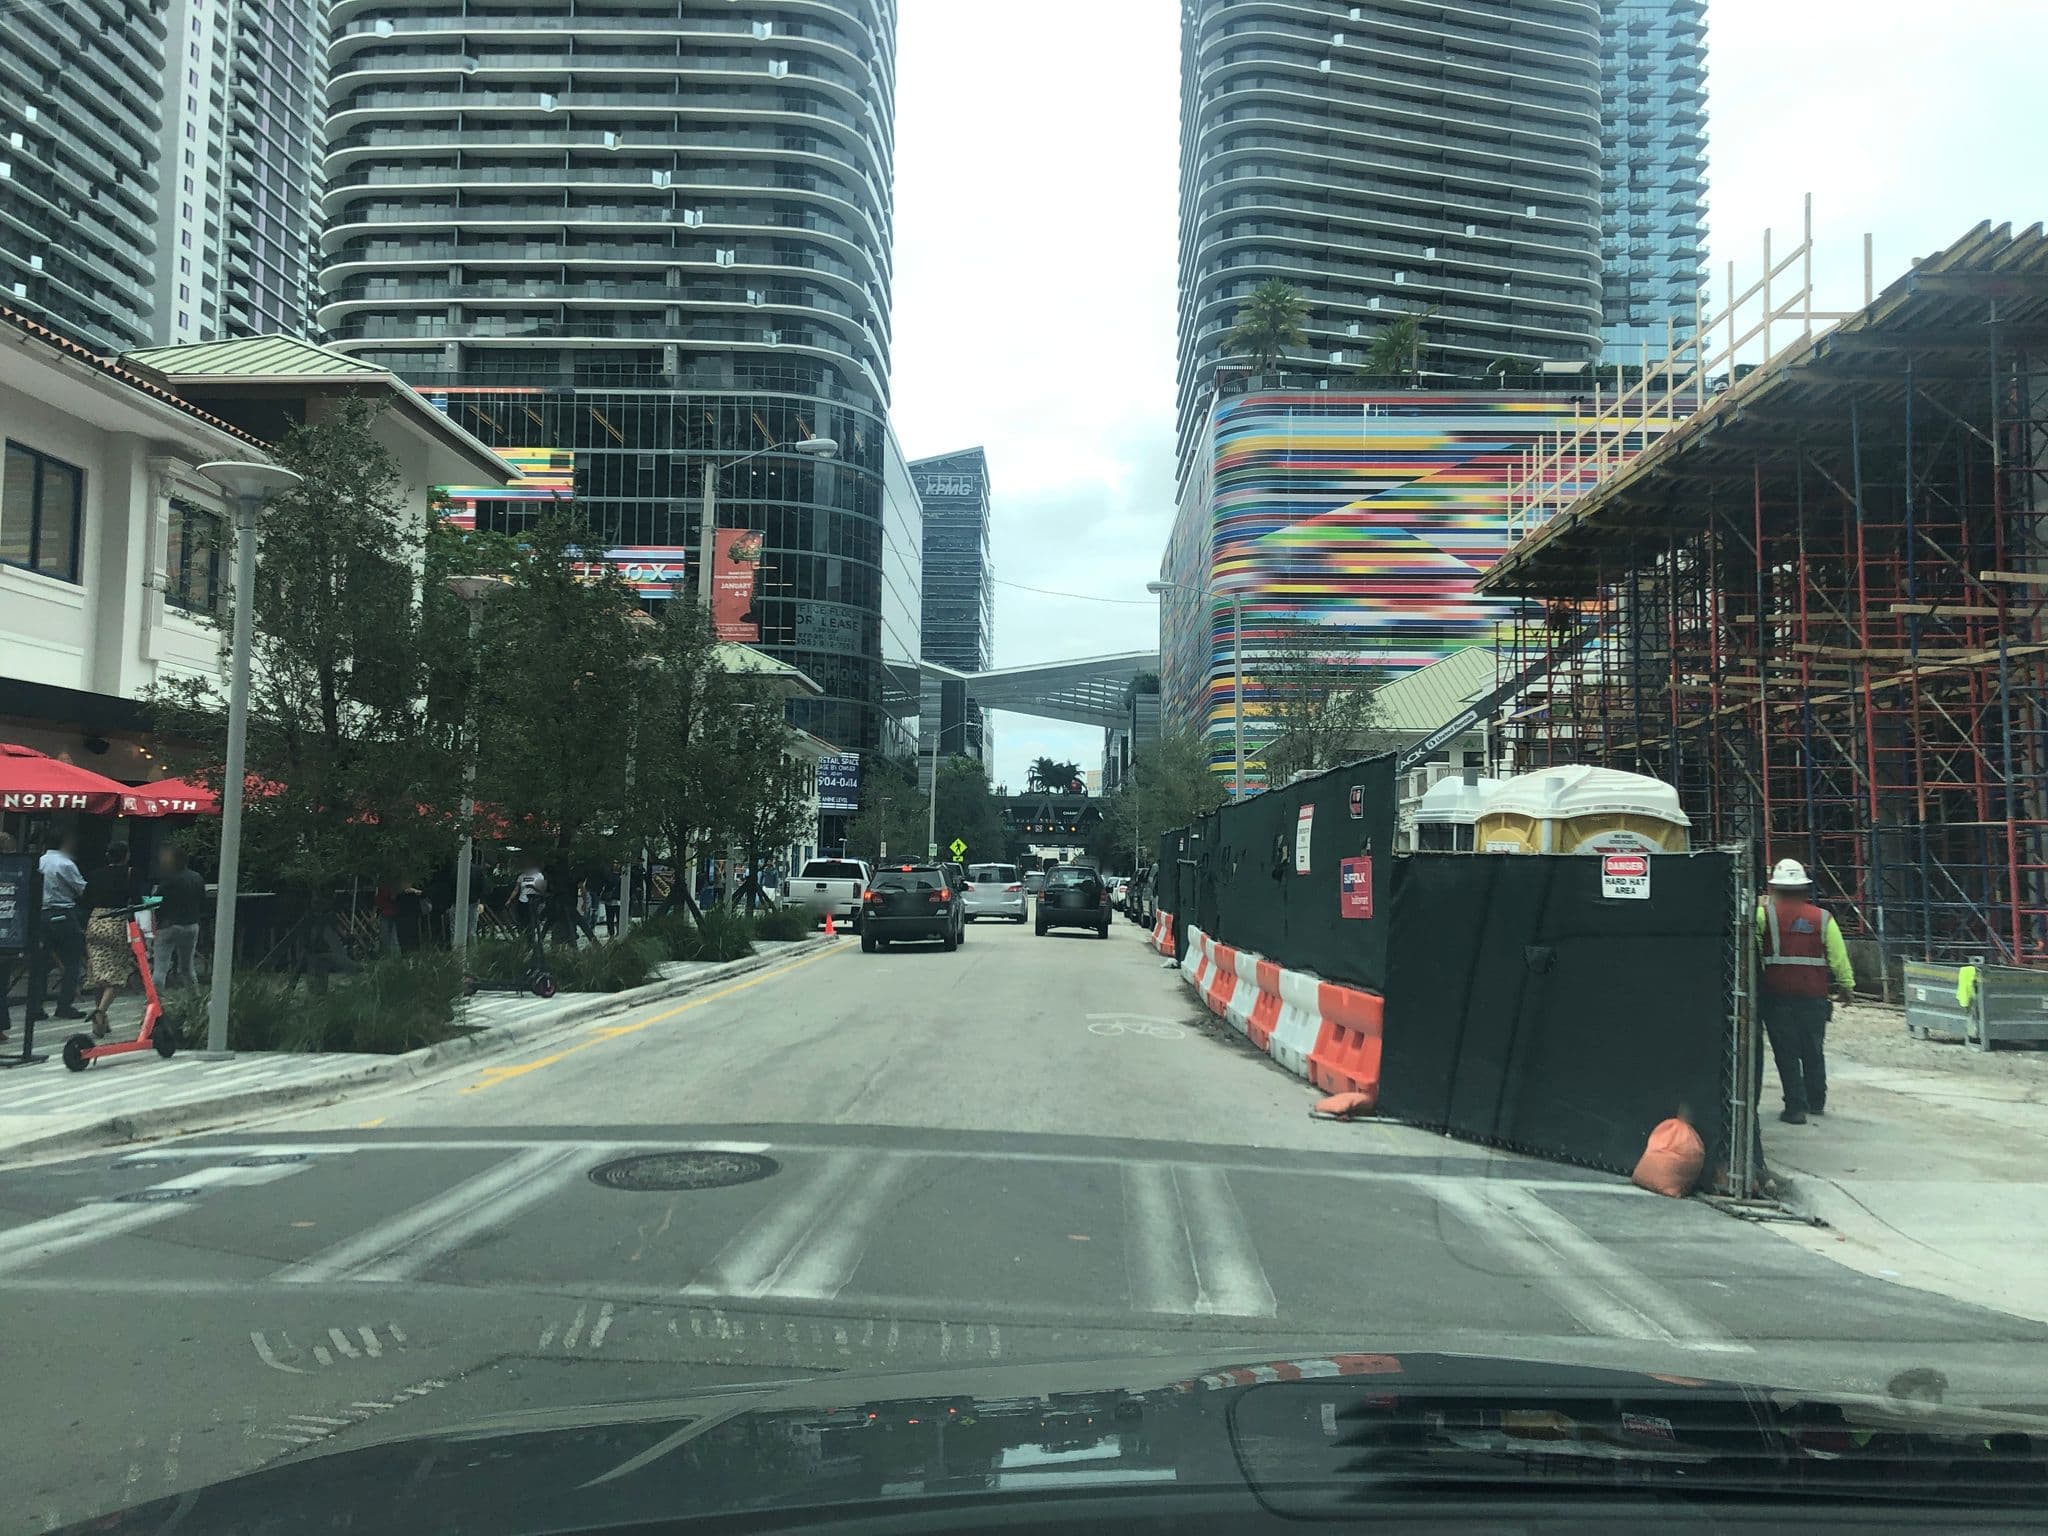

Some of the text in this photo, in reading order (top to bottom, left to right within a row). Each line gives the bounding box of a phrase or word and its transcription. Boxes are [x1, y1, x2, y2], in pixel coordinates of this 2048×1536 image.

[926, 483, 971, 496] KPMG
[720, 582, 752, 590] JANUARY
[796, 614, 813, 625] OR
[821, 616, 860, 632] LEASE
[1435, 714, 1474, 742] United Rentals
[841, 757, 859, 766] SPACE
[1401, 747, 1427, 770] ACK
[4, 793, 88, 809] NORTH
[1606, 861, 1644, 871] DANGER
[1604, 877, 1647, 886] HARD HAT
[1614, 886, 1637, 895] AREA
